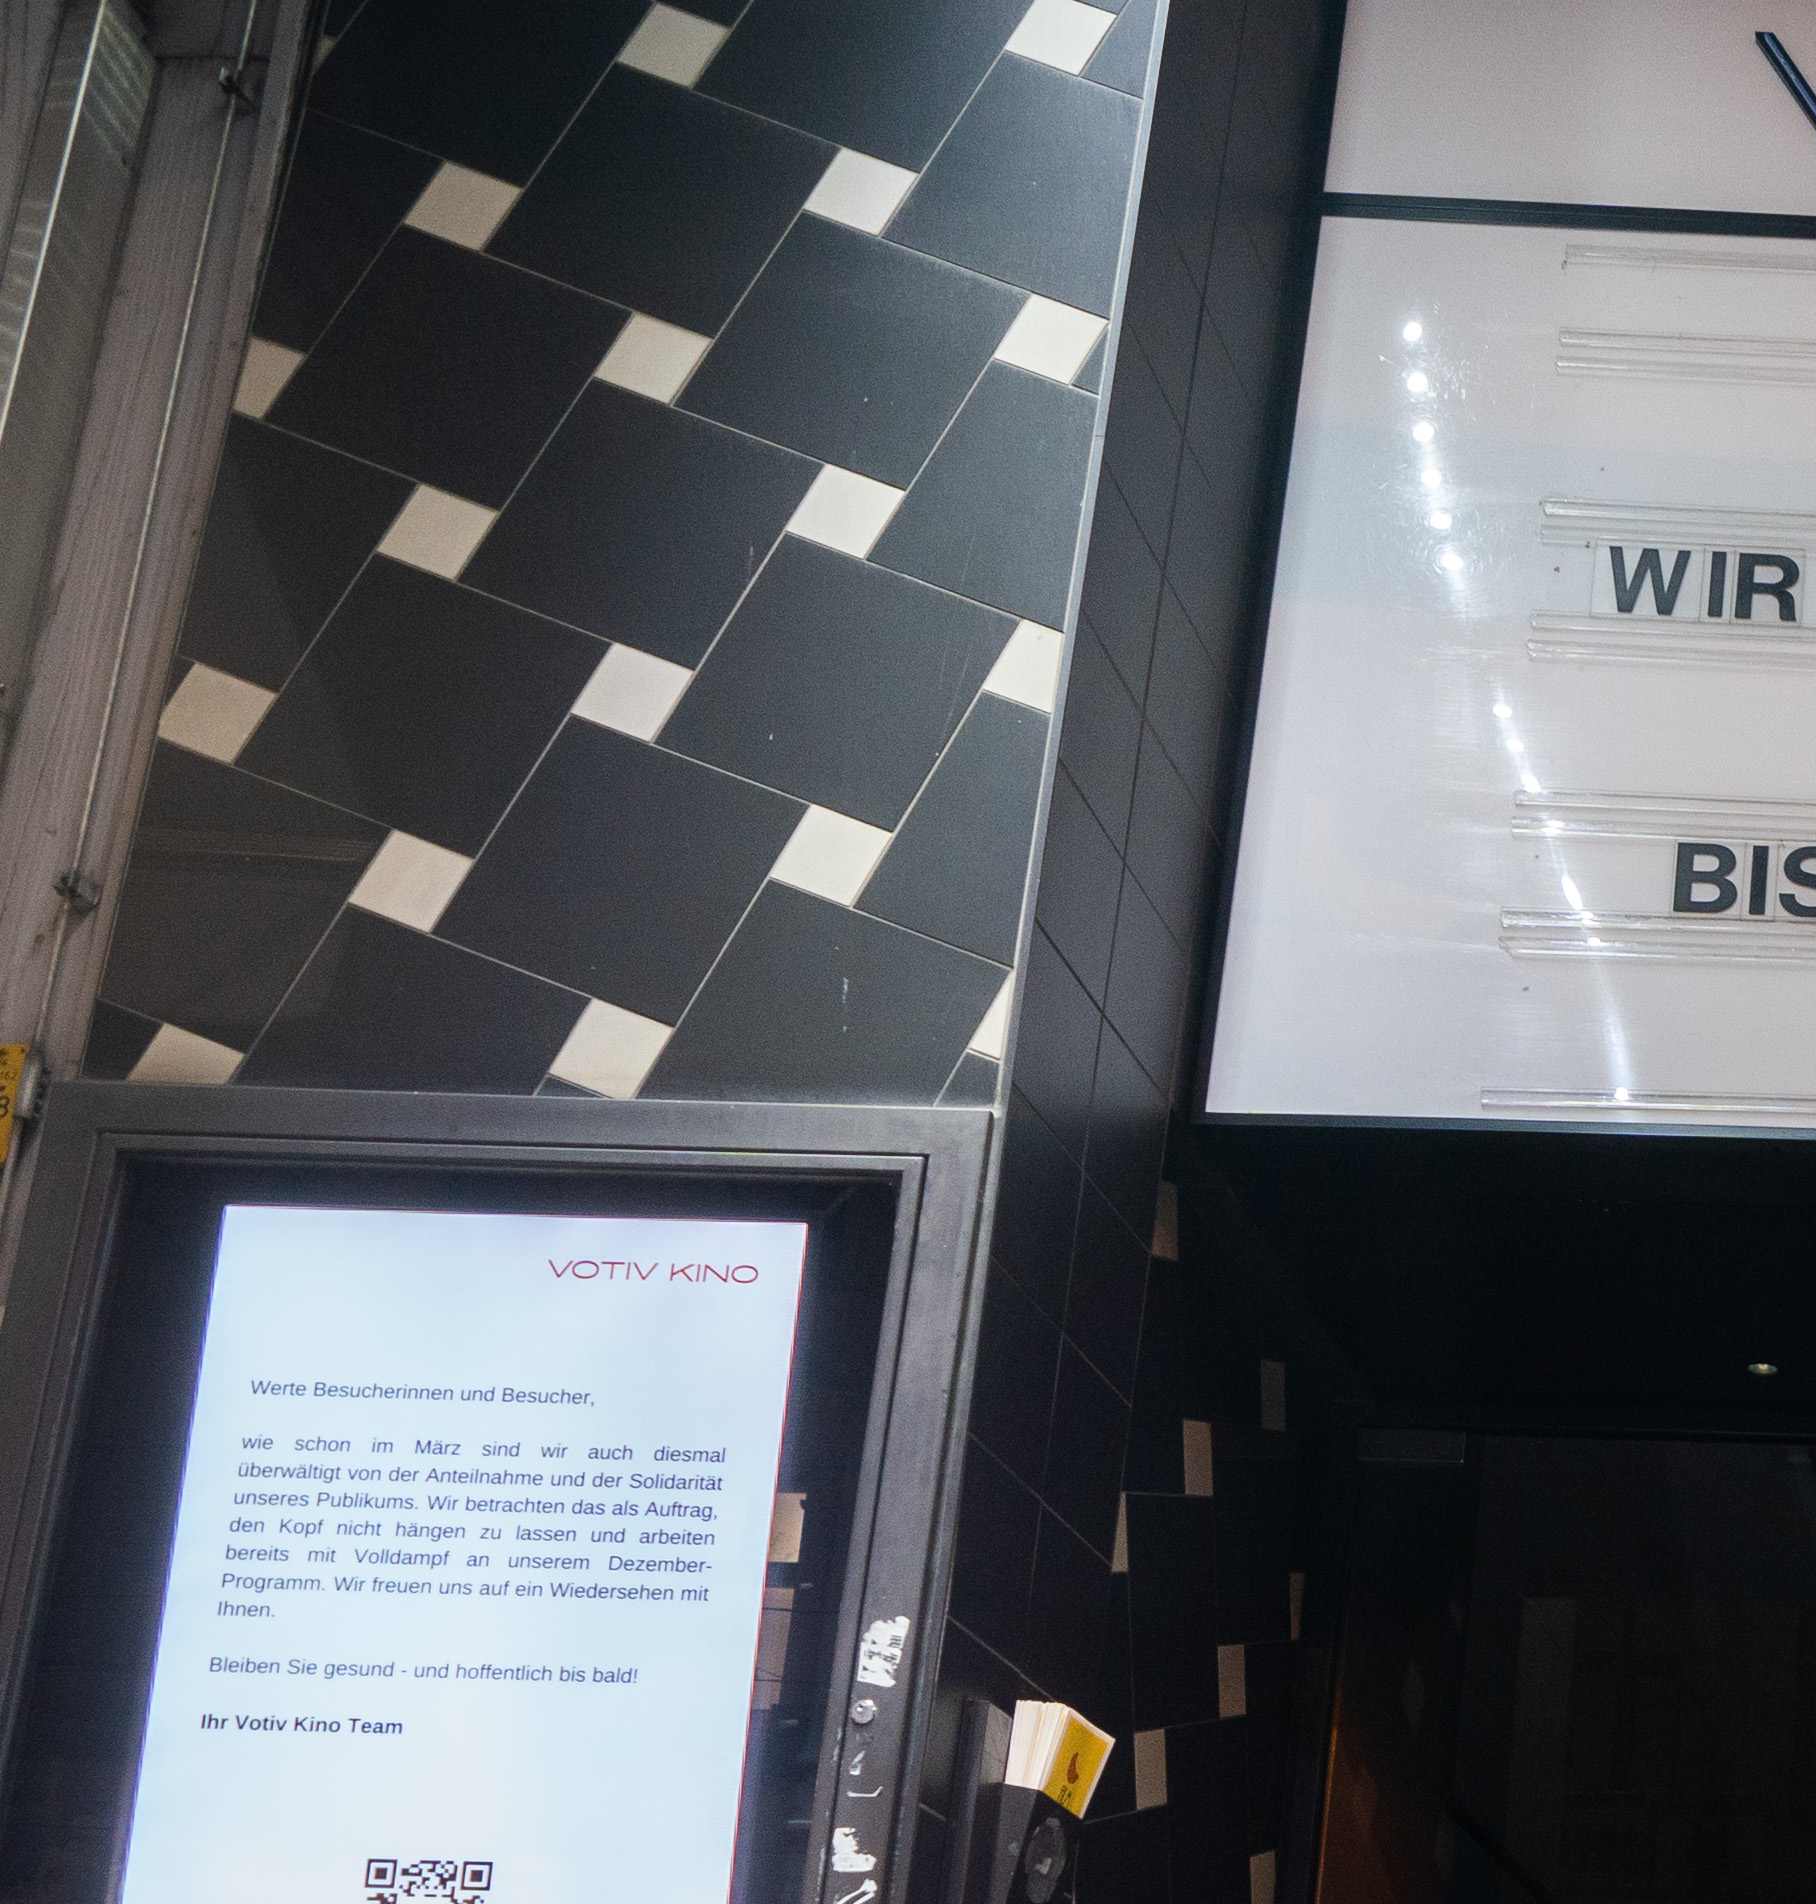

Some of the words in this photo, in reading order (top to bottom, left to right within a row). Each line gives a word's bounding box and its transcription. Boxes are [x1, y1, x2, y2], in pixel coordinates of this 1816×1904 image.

[1609, 545, 1801, 622] WIR
[548, 1259, 659, 1280] VOTIV
[669, 1263, 758, 1284] KINO
[250, 1379, 306, 1396] Werte
[312, 1381, 454, 1400] Besucherinnen
[460, 1386, 495, 1402] und
[501, 1387, 594, 1407] Besucher,
[241, 1434, 273, 1450] wie
[293, 1435, 350, 1452] schon
[371, 1437, 393, 1453] im
[414, 1439, 461, 1455] März
[481, 1440, 520, 1457] sind
[540, 1442, 568, 1458] wir
[587, 1444, 633, 1460] auch
[653, 1445, 726, 1463] diesmal
[237, 1461, 341, 1484] überwältigt
[347, 1468, 381, 1480] von
[388, 1466, 419, 1482] der
[424, 1467, 543, 1486] Anteilnahme
[550, 1471, 585, 1487] und
[591, 1471, 623, 1488] der
[628, 1472, 723, 1491] Solidarität
[233, 1492, 309, 1506] unseres
[316, 1491, 418, 1509] Publikums.
[427, 1495, 459, 1510] Wir
[464, 1495, 564, 1514] betrachten
[571, 1498, 605, 1515] das
[611, 1499, 638, 1516] als
[644, 1500, 717, 1522] Auftrag,
[228, 1516, 264, 1532] den
[279, 1518, 324, 1538] Kopf
[336, 1519, 381, 1536] nicht
[395, 1521, 465, 1542] hängen
[479, 1527, 501, 1539] zu
[515, 1524, 576, 1542] lassen
[590, 1527, 626, 1543] und
[638, 1528, 715, 1545] arbeiten
[225, 1543, 288, 1561] bereits
[307, 1547, 336, 1562] mit
[354, 1548, 450, 1569] Volldampf
[466, 1554, 489, 1567] an
[508, 1555, 589, 1569] unserem
[607, 1555, 712, 1573] Dezember-
[221, 1572, 324, 1593] Programm.
[334, 1575, 366, 1591] Wir
[372, 1576, 431, 1593] freuen
[438, 1582, 472, 1595] uns
[478, 1580, 510, 1596] auf
[514, 1580, 543, 1597] ein
[549, 1582, 674, 1600] Wiedersehen
[680, 1585, 709, 1601] mit
[217, 1600, 274, 1617] Ihnen.
[208, 1656, 280, 1673] Bleiben
[286, 1658, 317, 1675] Sie
[323, 1661, 395, 1679] gesund
[413, 1663, 449, 1678] und
[455, 1663, 552, 1681] hoffentlich
[559, 1665, 586, 1682] bis
[591, 1666, 638, 1683] bald!
[200, 1713, 228, 1729] Ihr
[235, 1714, 287, 1731] Votiv
[293, 1716, 340, 1732] Kino
[347, 1717, 402, 1734] Team
